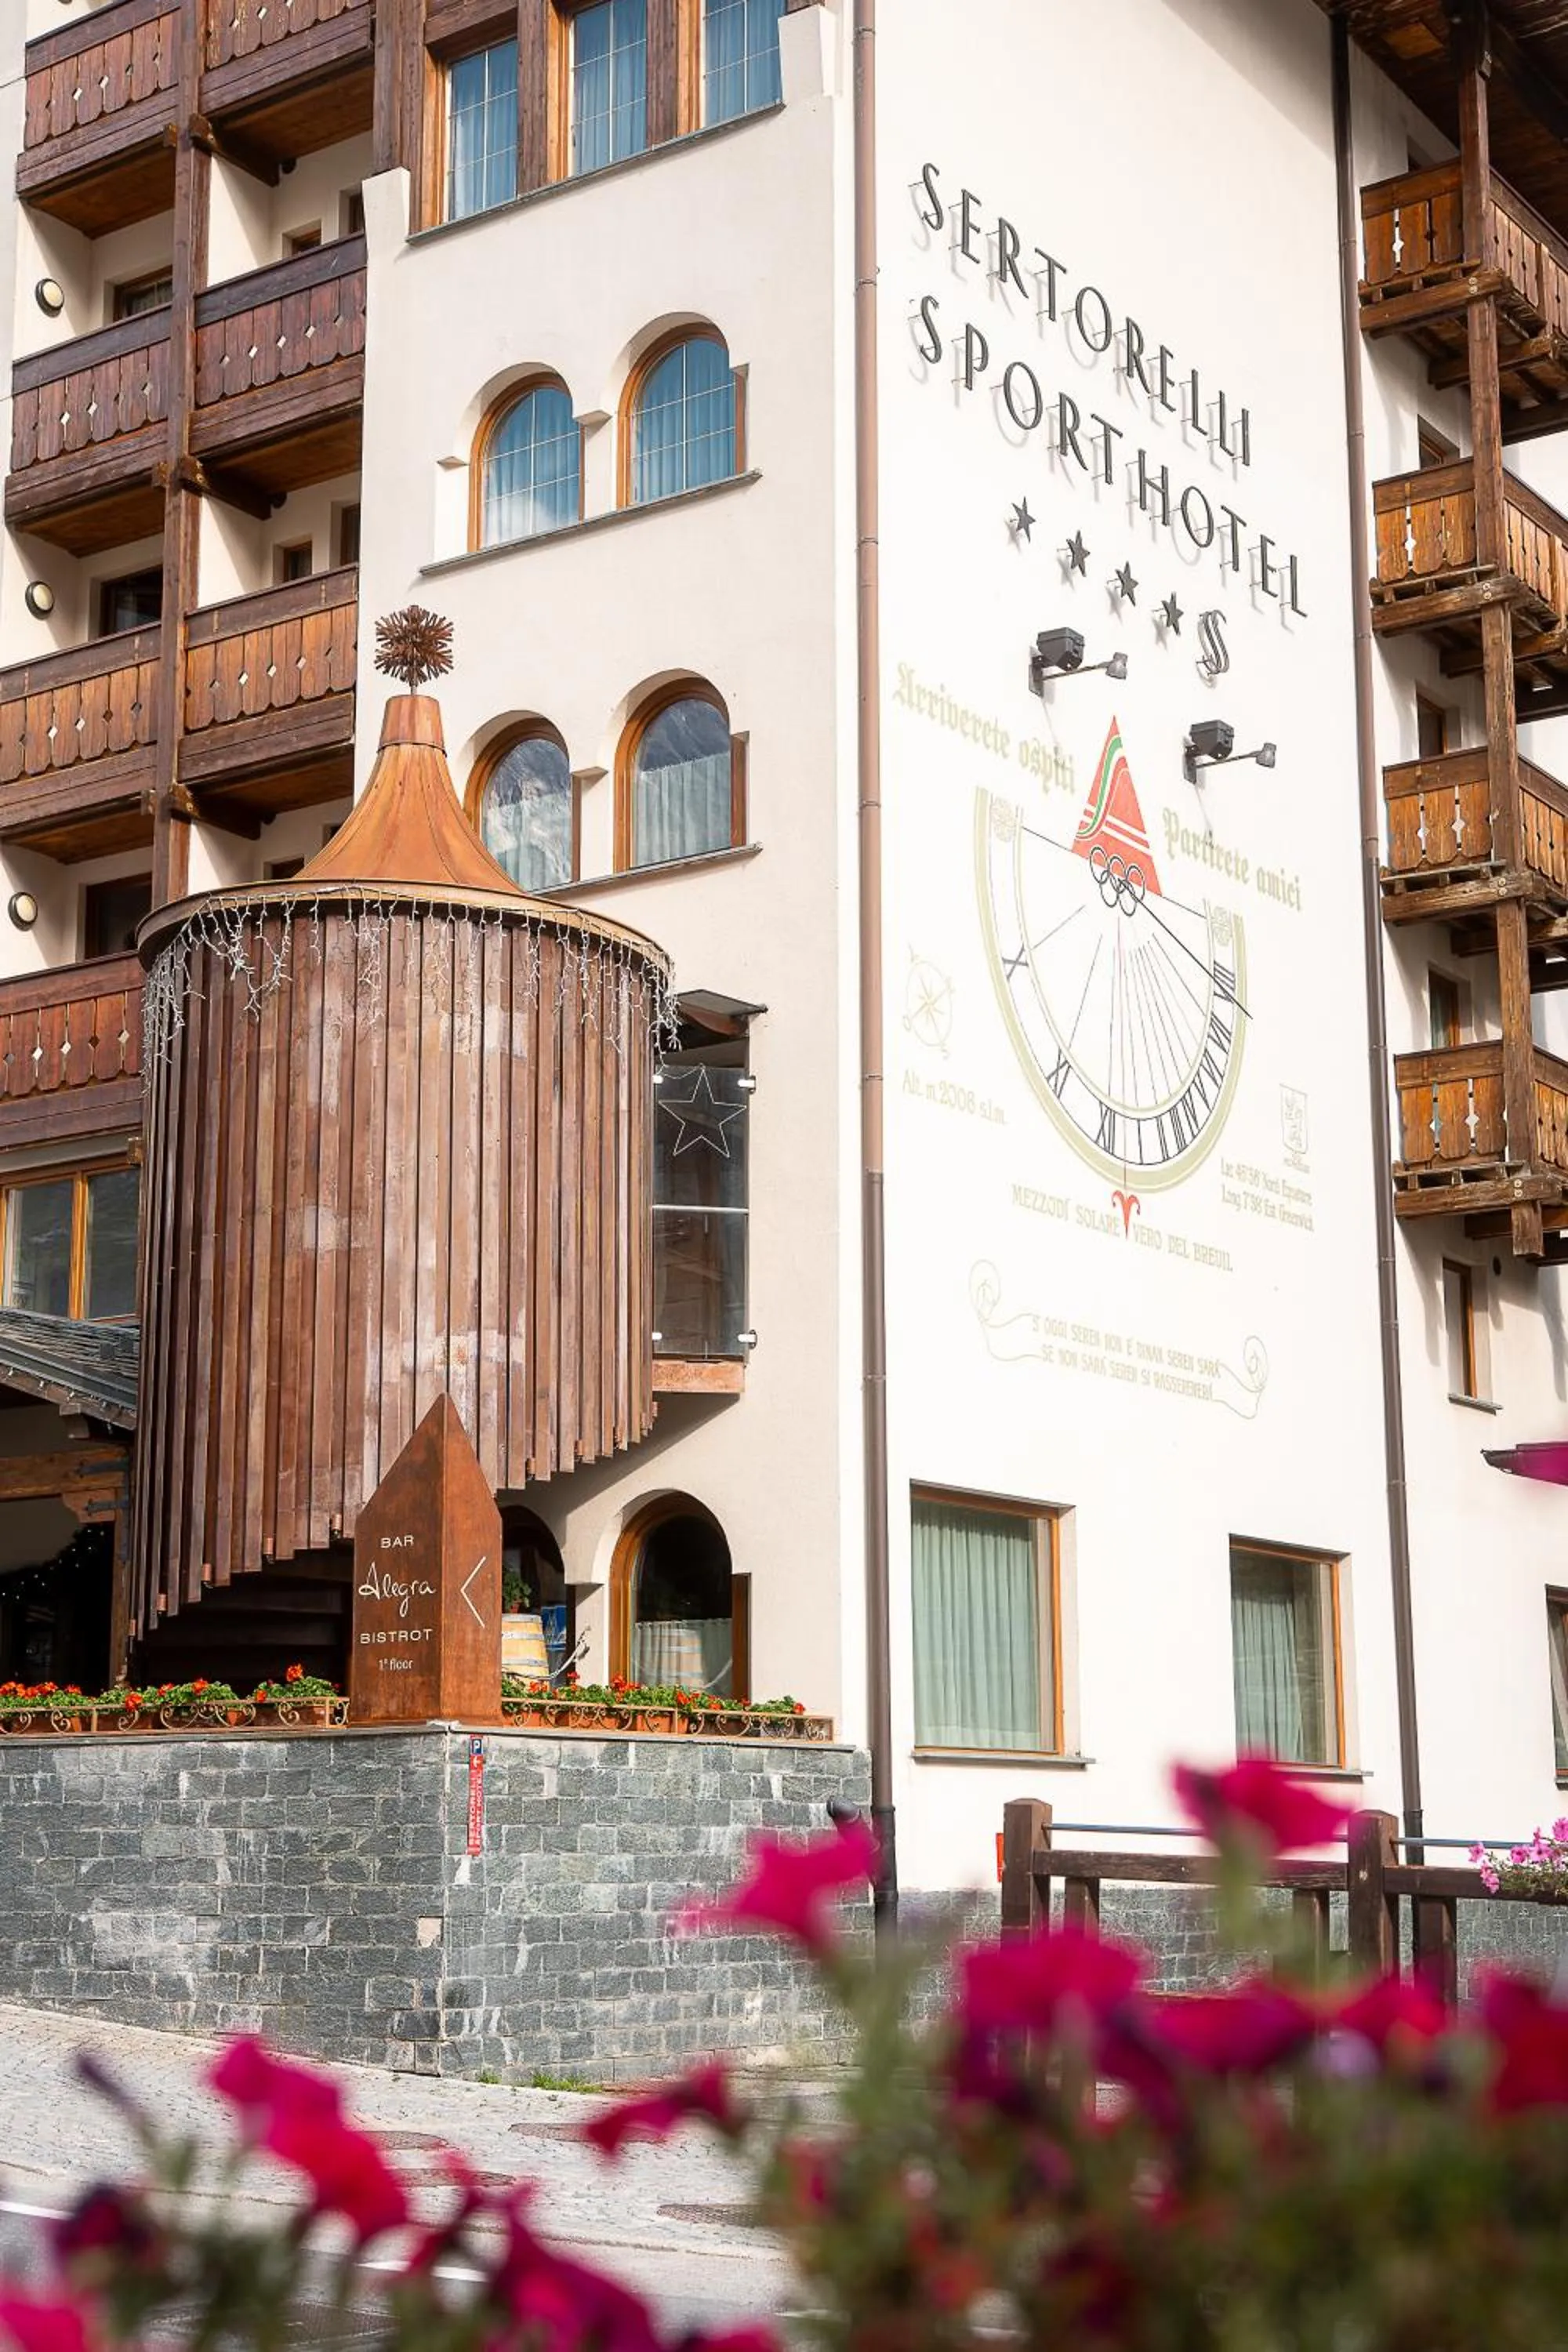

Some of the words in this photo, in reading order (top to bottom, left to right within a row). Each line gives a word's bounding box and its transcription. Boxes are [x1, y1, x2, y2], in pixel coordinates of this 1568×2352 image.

[921, 163, 1250, 466] SERTORELLI
[920, 296, 1307, 617] SPORTHOTEL
[892, 662, 1010, 759] Arriverete
[1019, 738, 1075, 794] ospiti
[1256, 866, 1301, 911] amici
[1076, 1204, 1120, 1239] SOLARE
[1132, 1222, 1162, 1250] VERO
[1167, 1235, 1190, 1259] DEL
[380, 1534, 414, 1549] BAR
[358, 1560, 437, 1618] Alegra
[359, 1628, 433, 1645] BISTROT
[390, 1658, 413, 1671] floor
